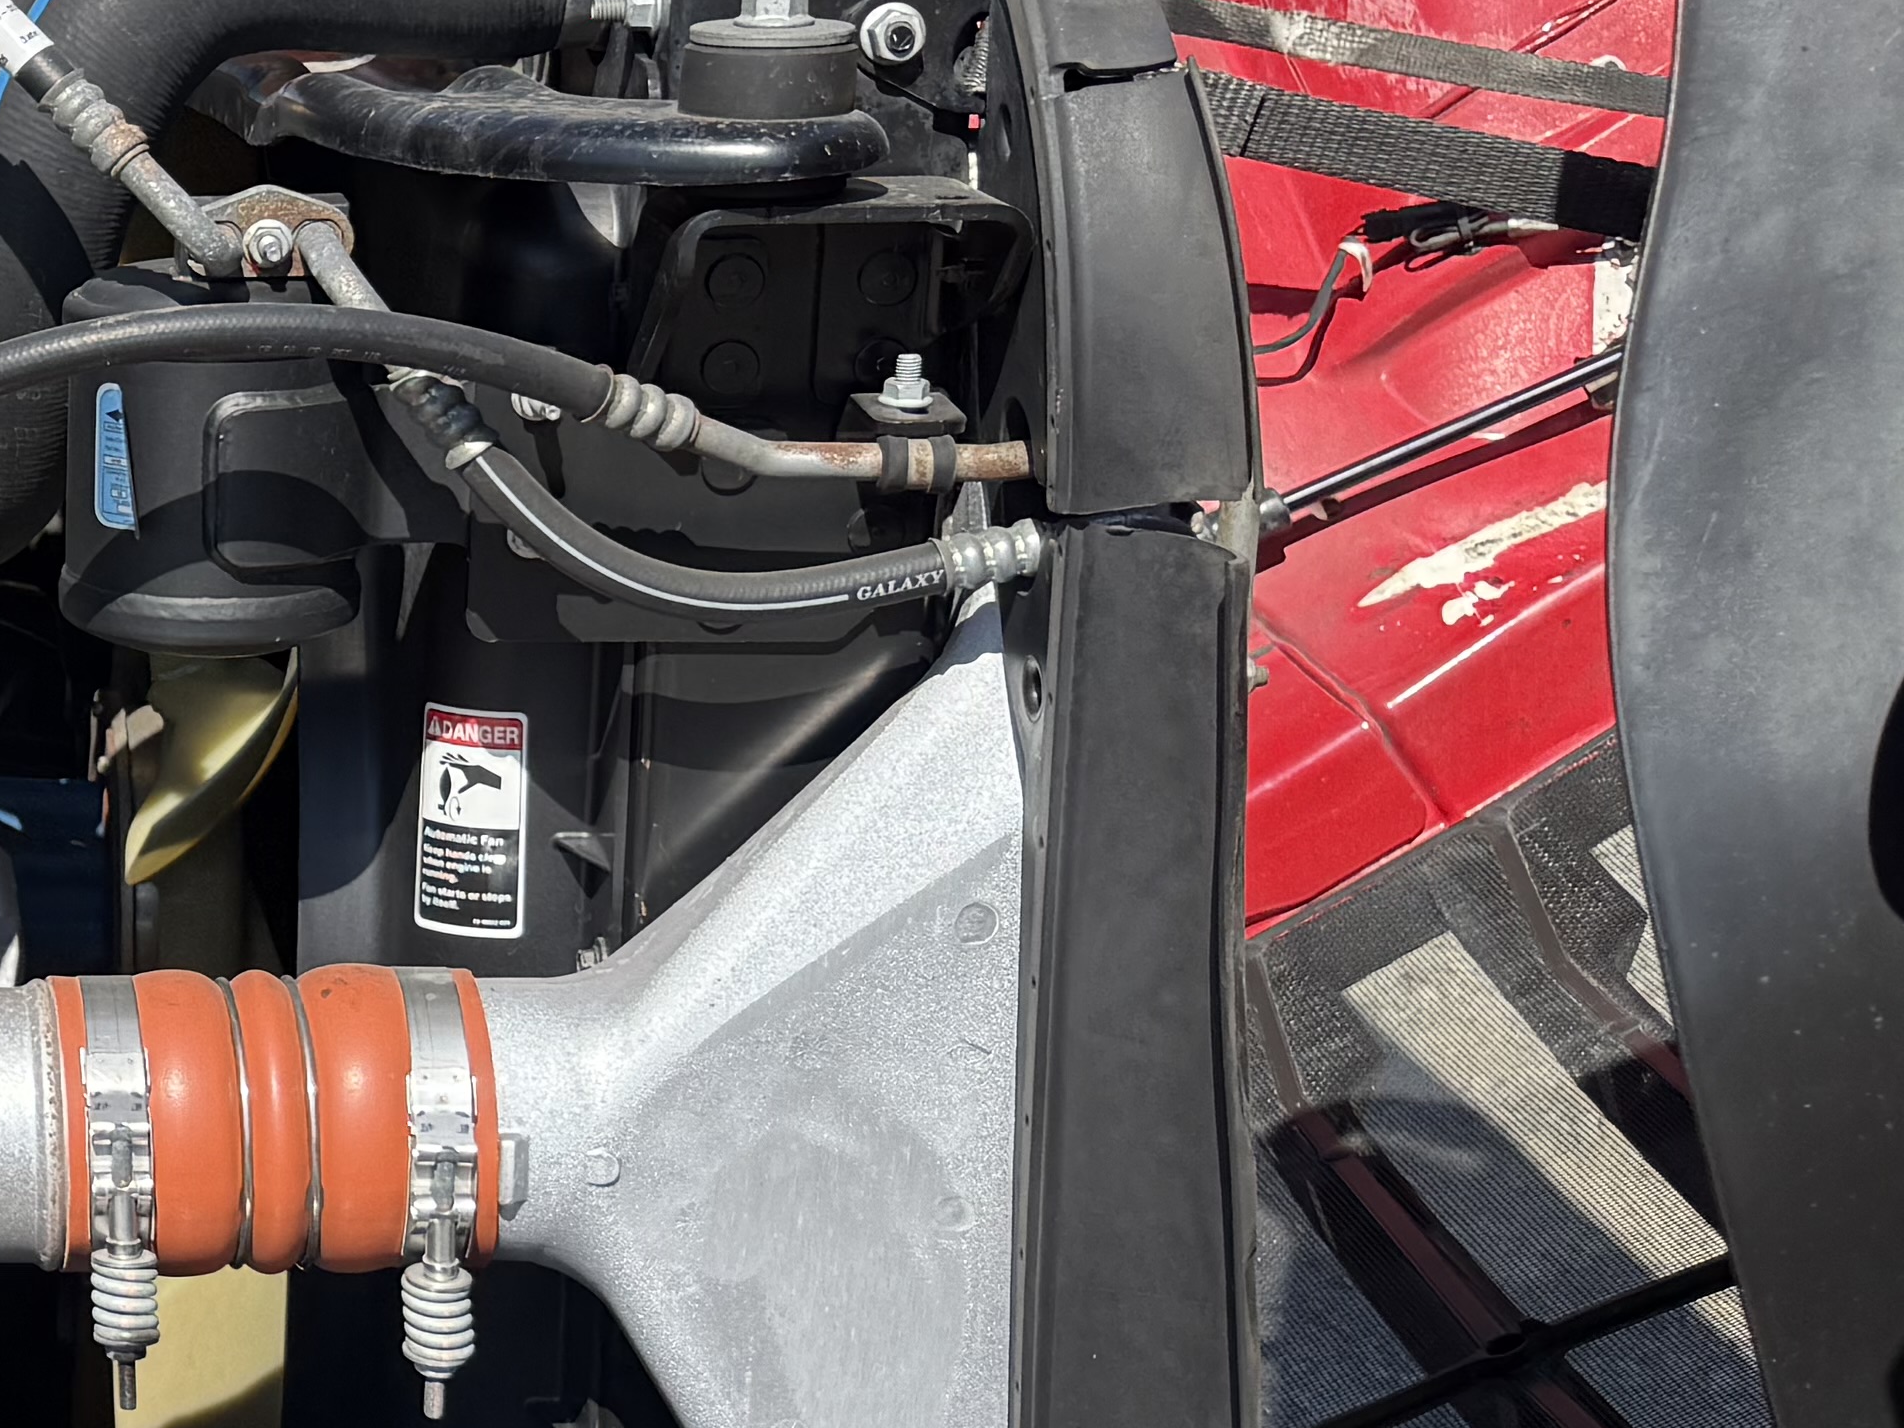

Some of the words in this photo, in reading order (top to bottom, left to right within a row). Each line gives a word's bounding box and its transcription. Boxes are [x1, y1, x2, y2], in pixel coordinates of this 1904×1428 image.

[856, 569, 944, 601] GALAXY
[442, 720, 520, 745] DANGER
[424, 826, 478, 845] Automatic
[480, 834, 504, 847] Fan
[445, 847, 477, 861] hands
[445, 861, 480, 873] engine
[481, 864, 492, 874] is
[422, 881, 437, 893] Fan
[437, 887, 466, 899] starts
[467, 892, 480, 901] or
[481, 892, 512, 904] stops
